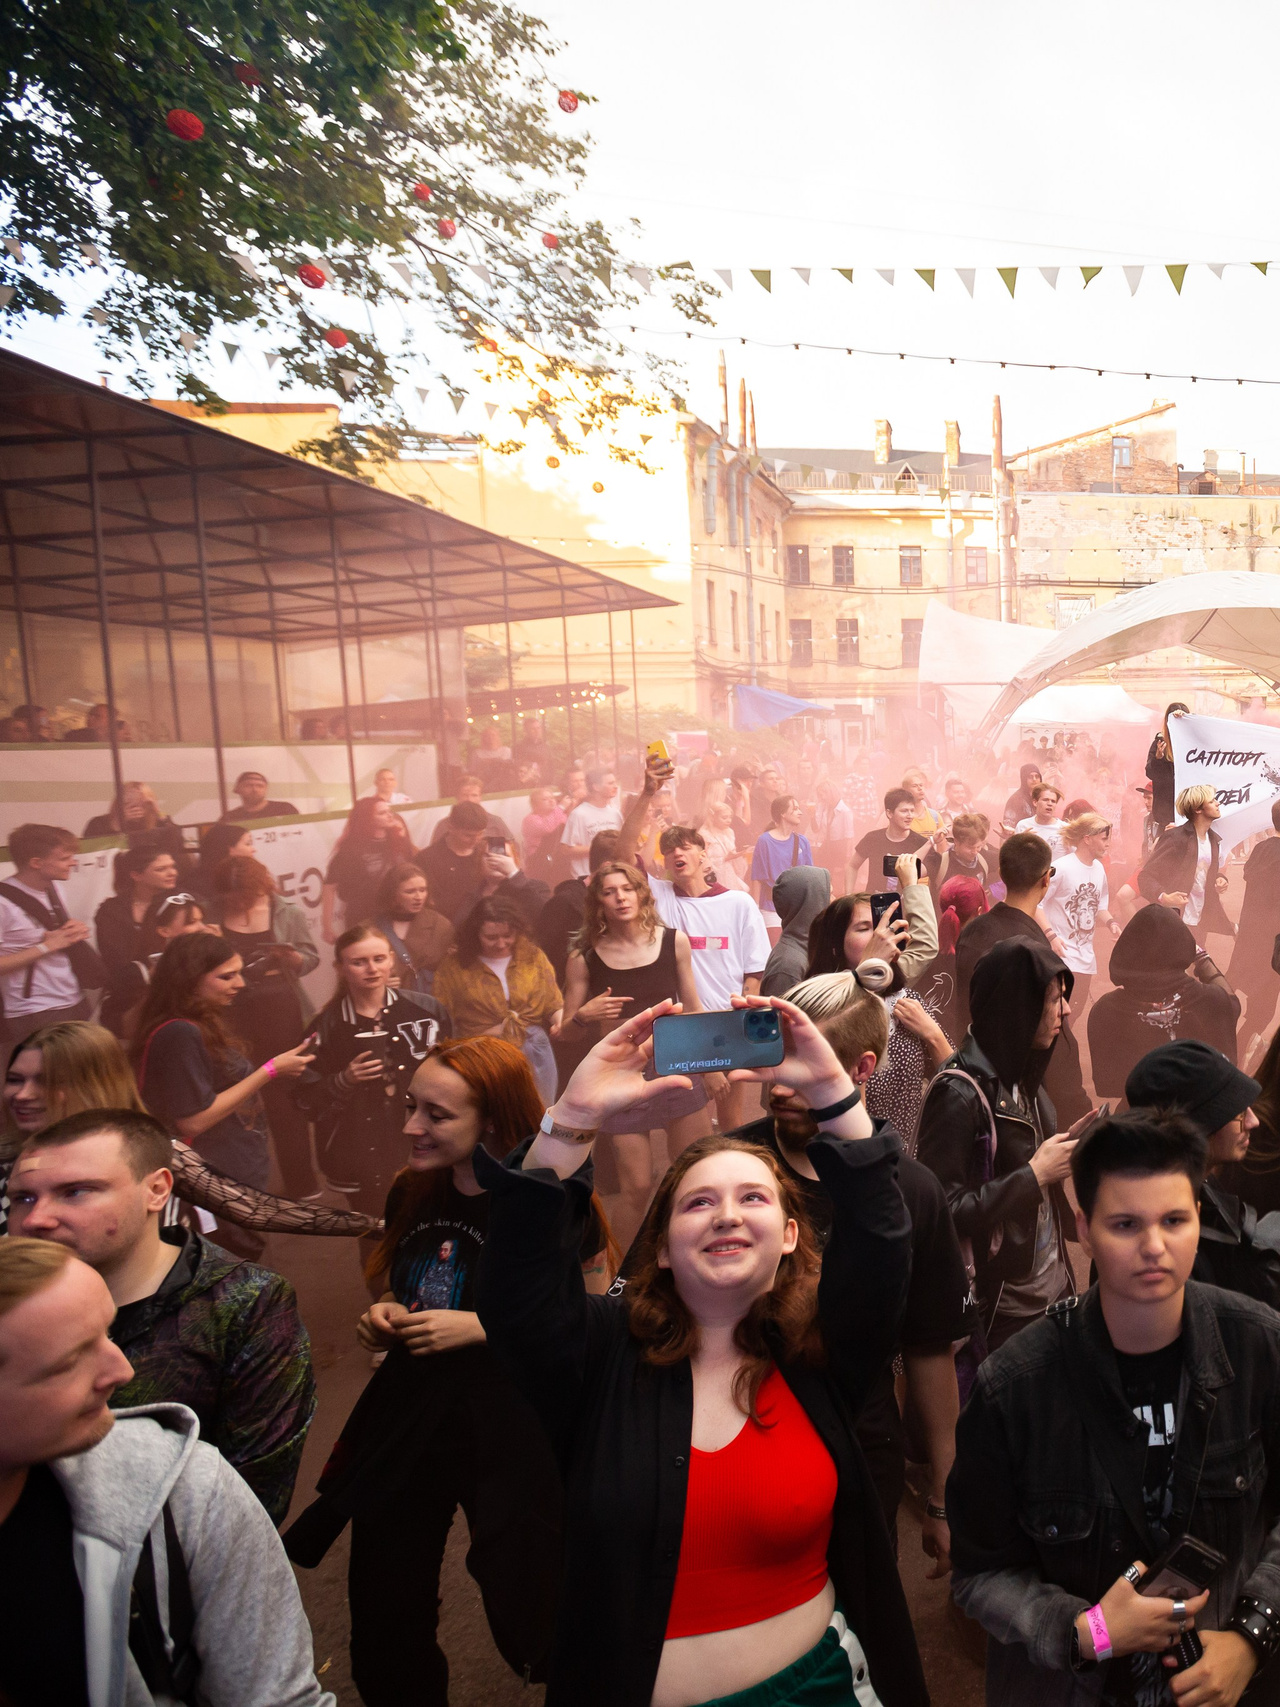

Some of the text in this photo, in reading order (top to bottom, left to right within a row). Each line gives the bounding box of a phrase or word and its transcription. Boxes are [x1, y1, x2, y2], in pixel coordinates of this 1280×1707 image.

[1186, 748, 1265, 767] САППОРТ
[397, 1018, 439, 1060] V
[417, 1222, 431, 1232] the
[452, 1220, 463, 1229] of
[468, 1226, 485, 1245] killer
